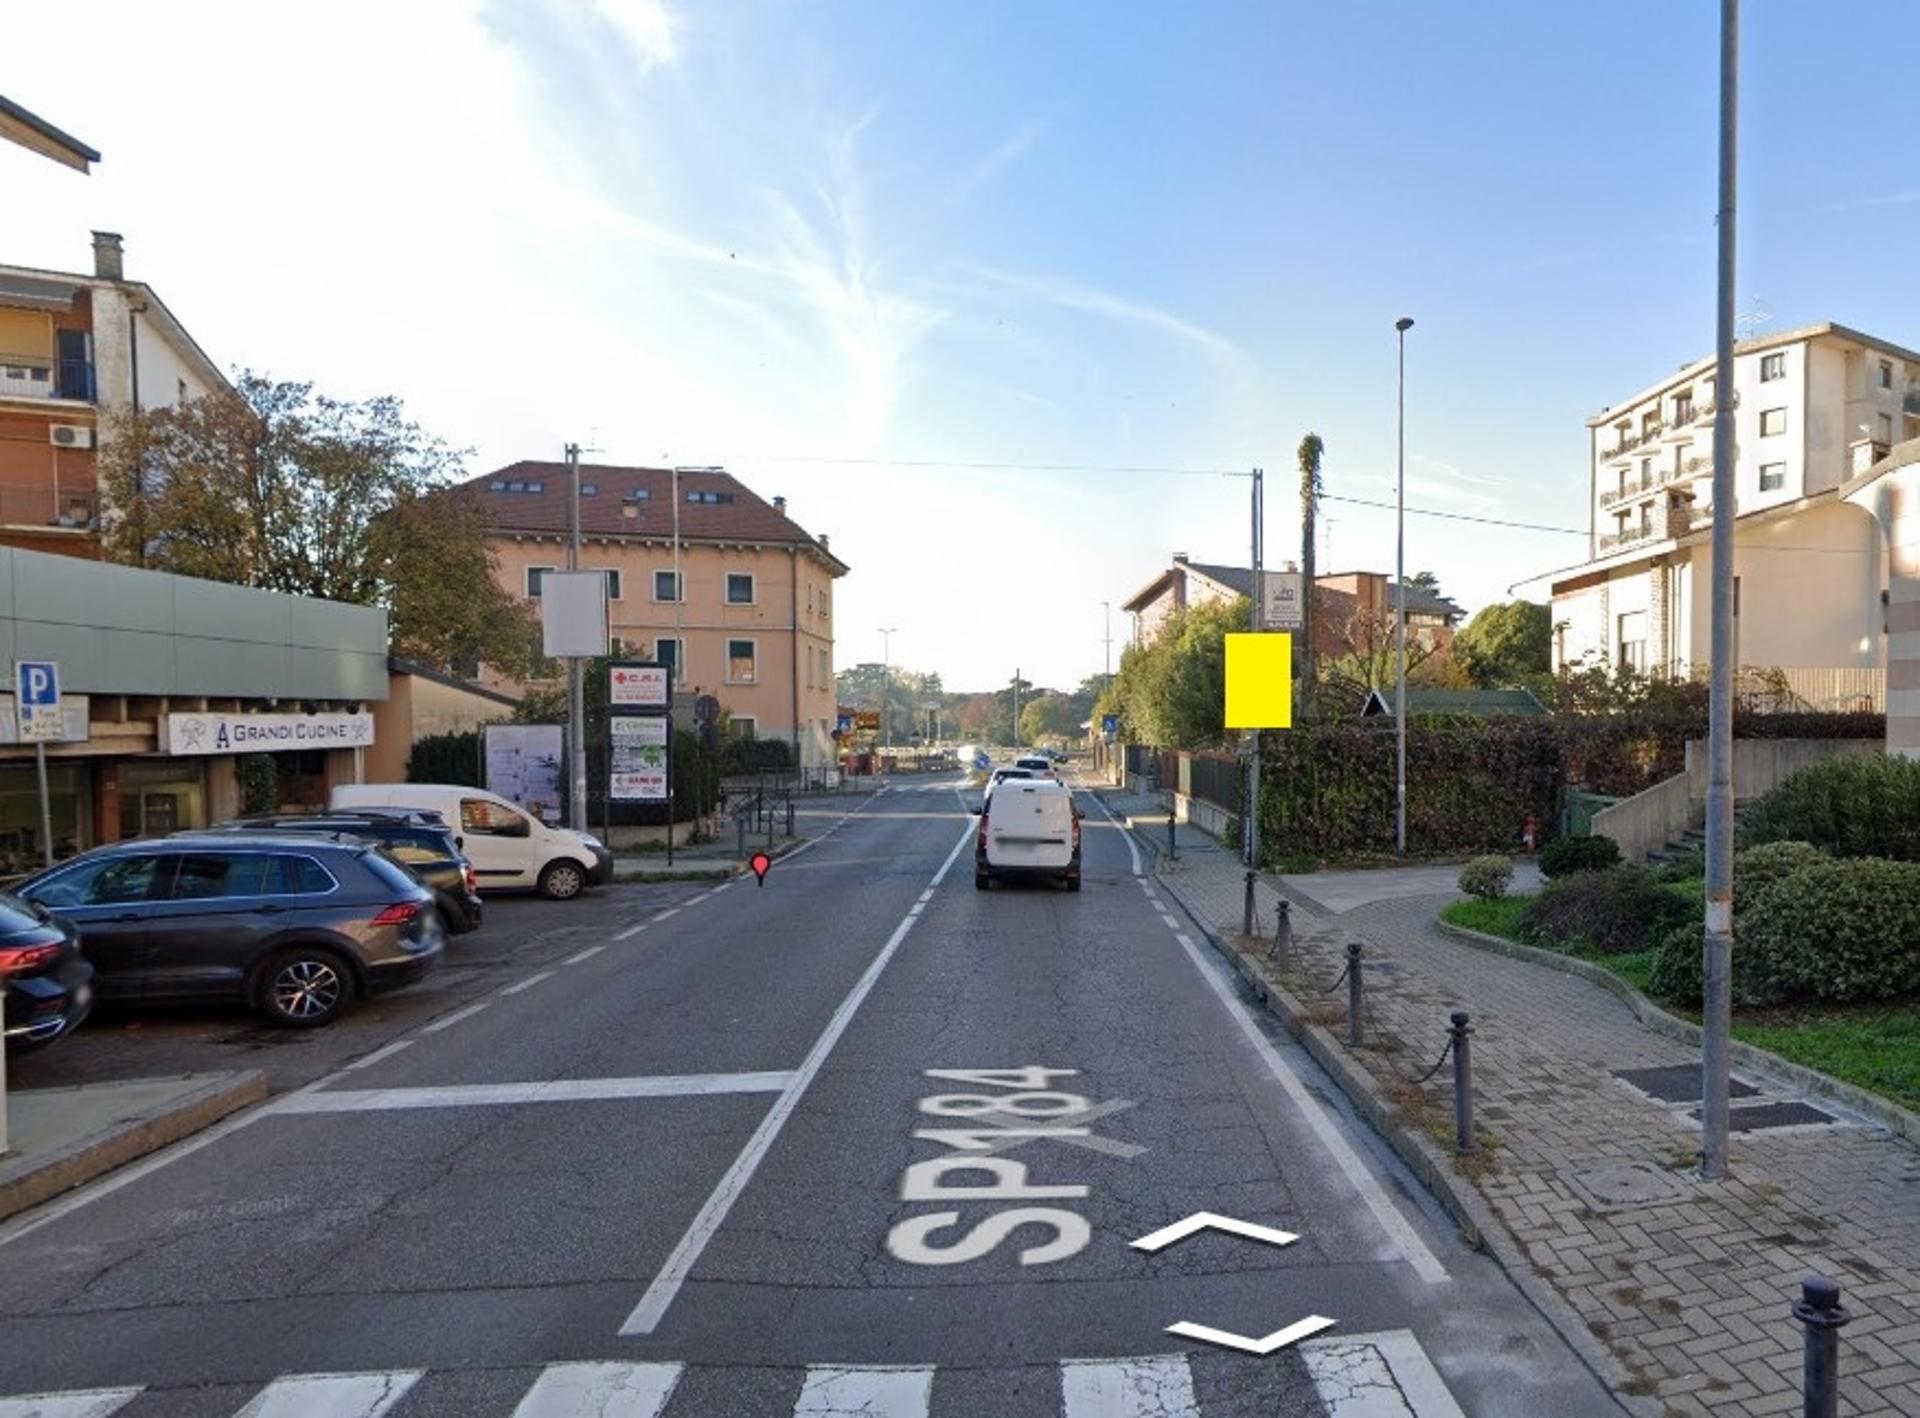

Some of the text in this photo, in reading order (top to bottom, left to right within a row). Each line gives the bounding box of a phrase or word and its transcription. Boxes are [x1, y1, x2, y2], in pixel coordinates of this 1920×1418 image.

[29, 668, 48, 700] P
[234, 724, 293, 742] GRANDI
[295, 723, 347, 740] CUCINE
